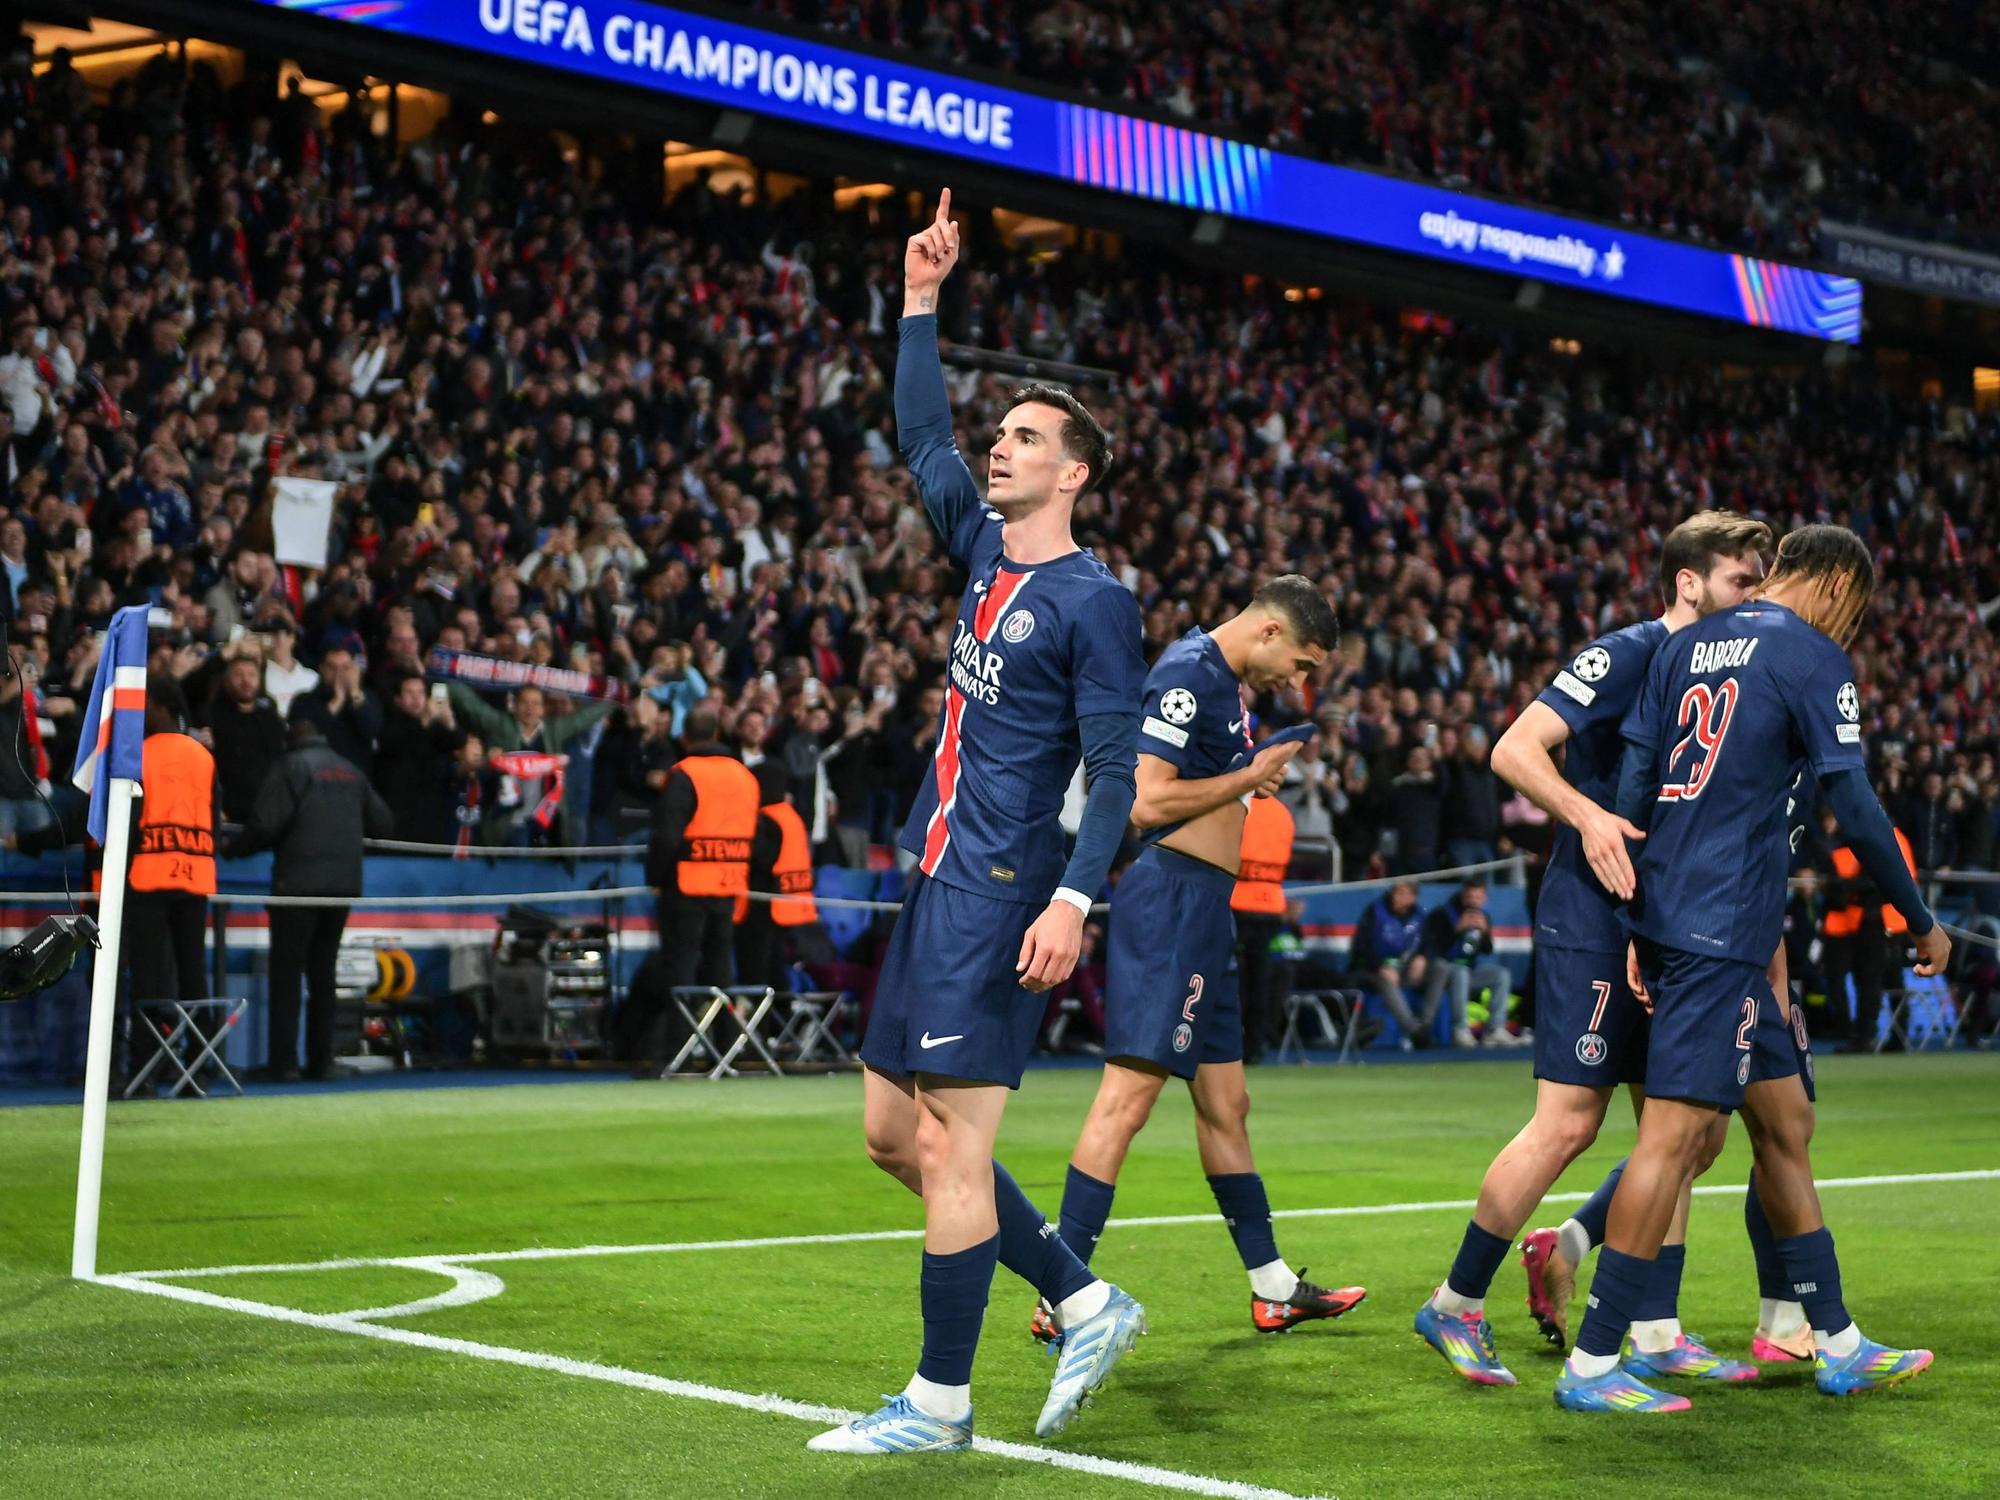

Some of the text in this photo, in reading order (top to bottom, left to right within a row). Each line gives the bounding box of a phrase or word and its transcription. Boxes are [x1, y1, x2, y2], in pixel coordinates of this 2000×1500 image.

[478, 0, 1013, 149] UEFA CHAMPIONS LEAGUE
[1419, 209, 1597, 278] enjoy responsibly
[1837, 240, 1901, 275] PARIS
[1689, 637, 1759, 674] BARCOLA
[1657, 676, 1740, 803] 29
[1182, 973, 1205, 1022] 2
[1588, 980, 1611, 1032] 7
[1735, 996, 1760, 1051] 2
